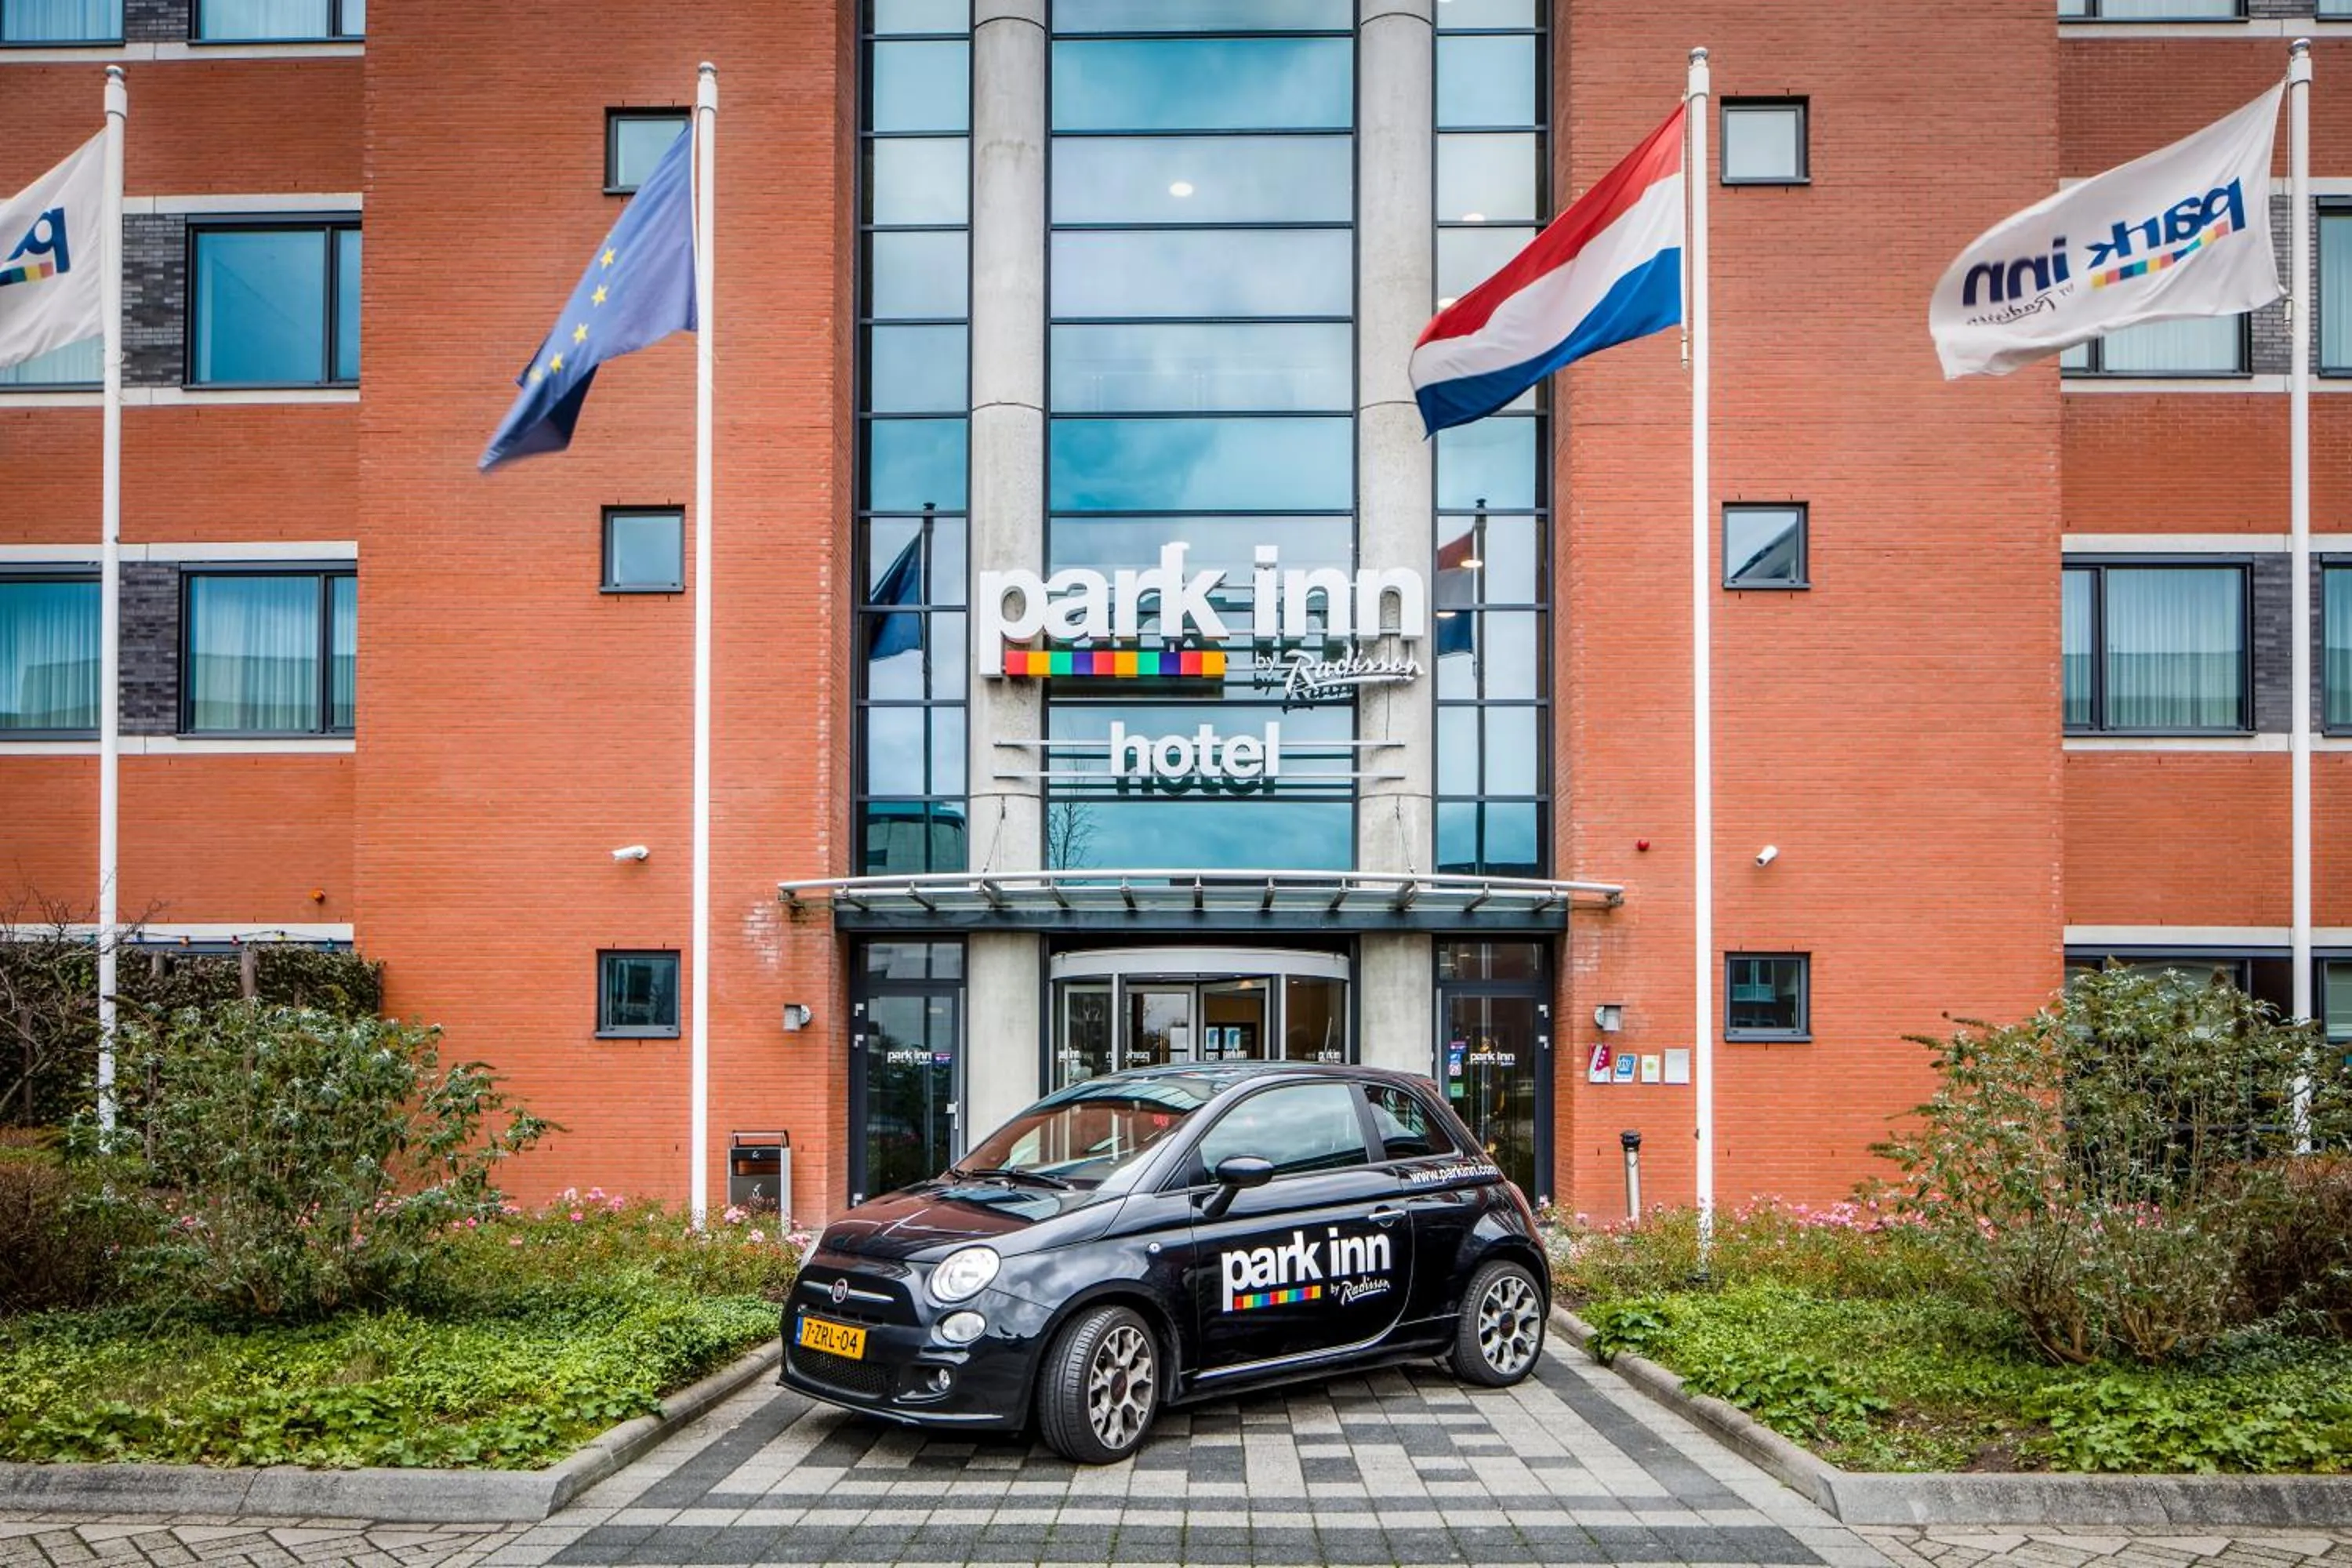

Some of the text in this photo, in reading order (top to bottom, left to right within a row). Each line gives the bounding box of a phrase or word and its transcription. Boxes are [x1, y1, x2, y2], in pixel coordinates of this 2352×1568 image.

[979, 542, 1425, 676] park inn
[1255, 641, 1425, 696] by Radisson
[1110, 721, 1280, 779] hotel
[887, 1050, 913, 1064] park
[1470, 1050, 1495, 1065] park
[1497, 1051, 1515, 1062] inn
[1410, 1163, 1498, 1184] www.parkinn.com
[1221, 1226, 1391, 1312] park inn
[1330, 1274, 1391, 1306] by Radisson
[804, 1322, 858, 1353] 7-ZRL-04
